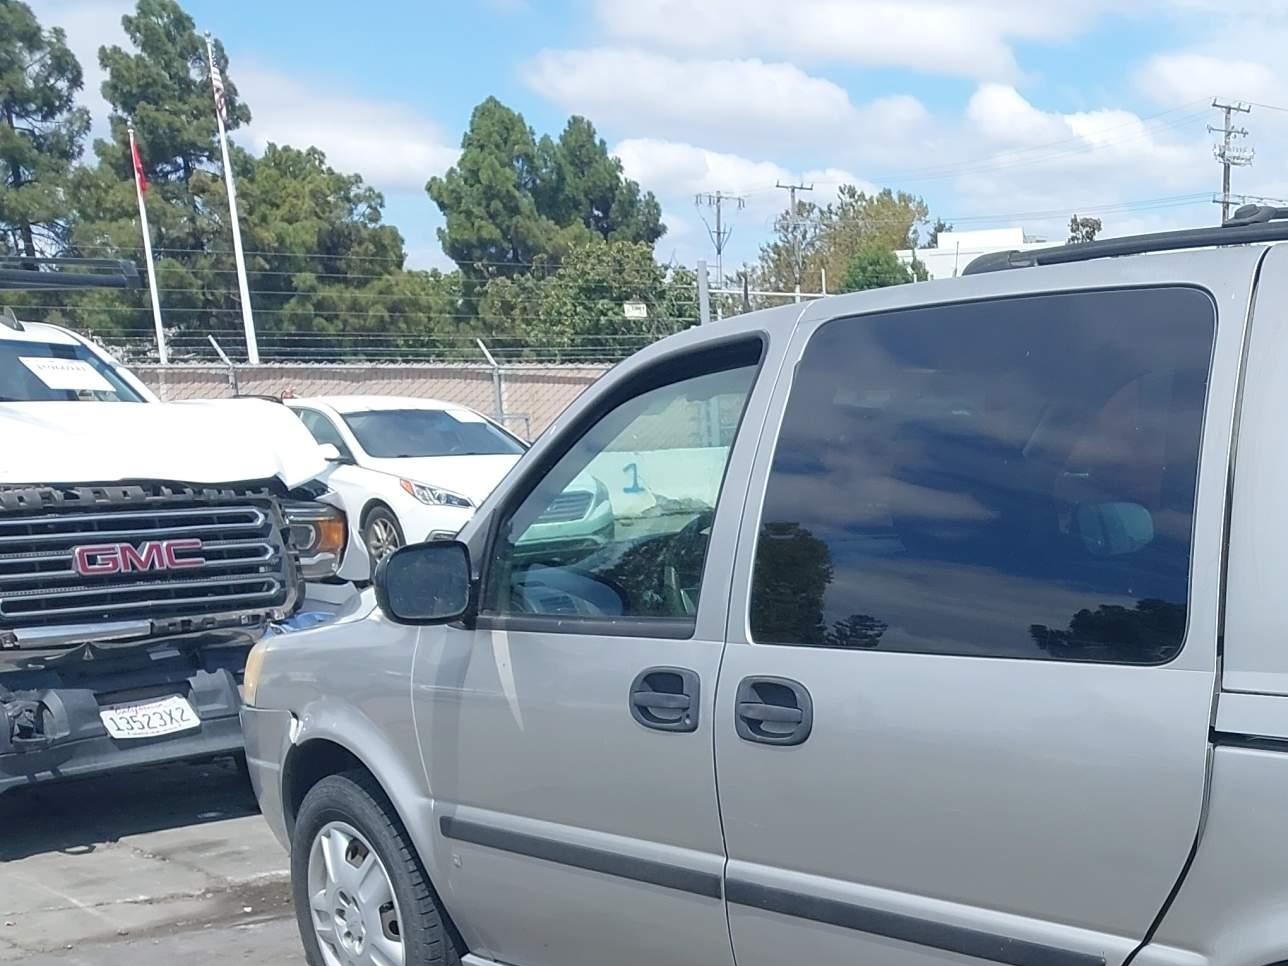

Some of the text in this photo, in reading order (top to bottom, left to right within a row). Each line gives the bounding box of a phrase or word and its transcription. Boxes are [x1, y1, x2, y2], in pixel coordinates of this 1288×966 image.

[622, 462, 646, 494] 1
[75, 538, 205, 575] GMC
[108, 706, 191, 732] 13523X2
